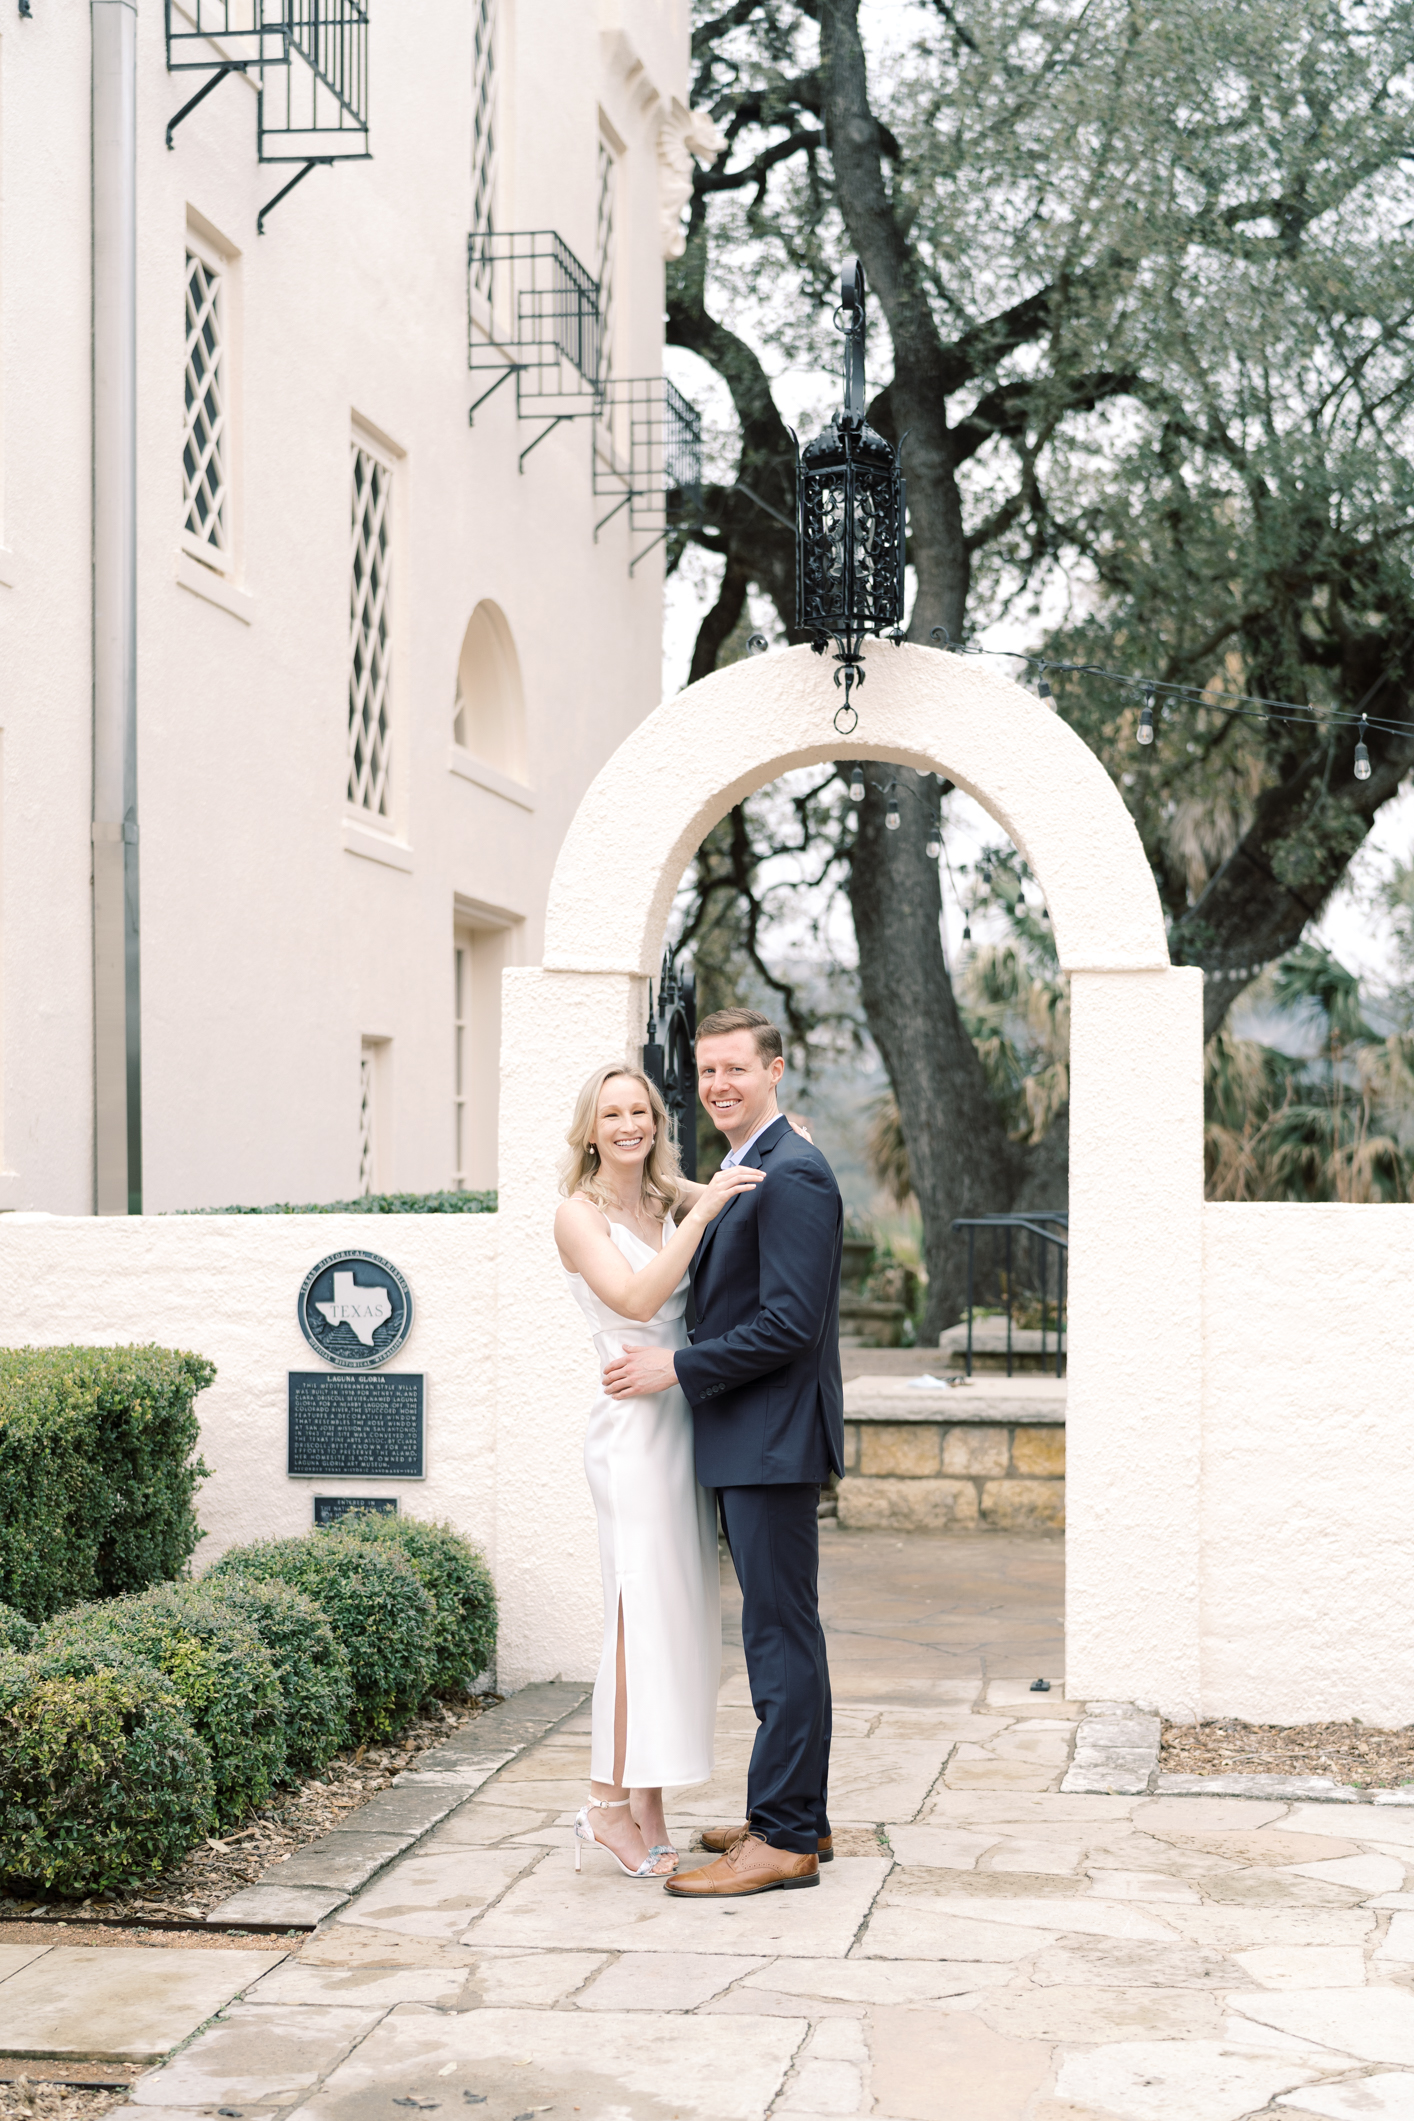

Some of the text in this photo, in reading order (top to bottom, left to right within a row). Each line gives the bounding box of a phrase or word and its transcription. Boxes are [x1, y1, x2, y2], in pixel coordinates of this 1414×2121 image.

[300, 1250, 408, 1293] TEXAS HISTORICAL COMMISSION
[330, 1304, 383, 1318] TEXAS
